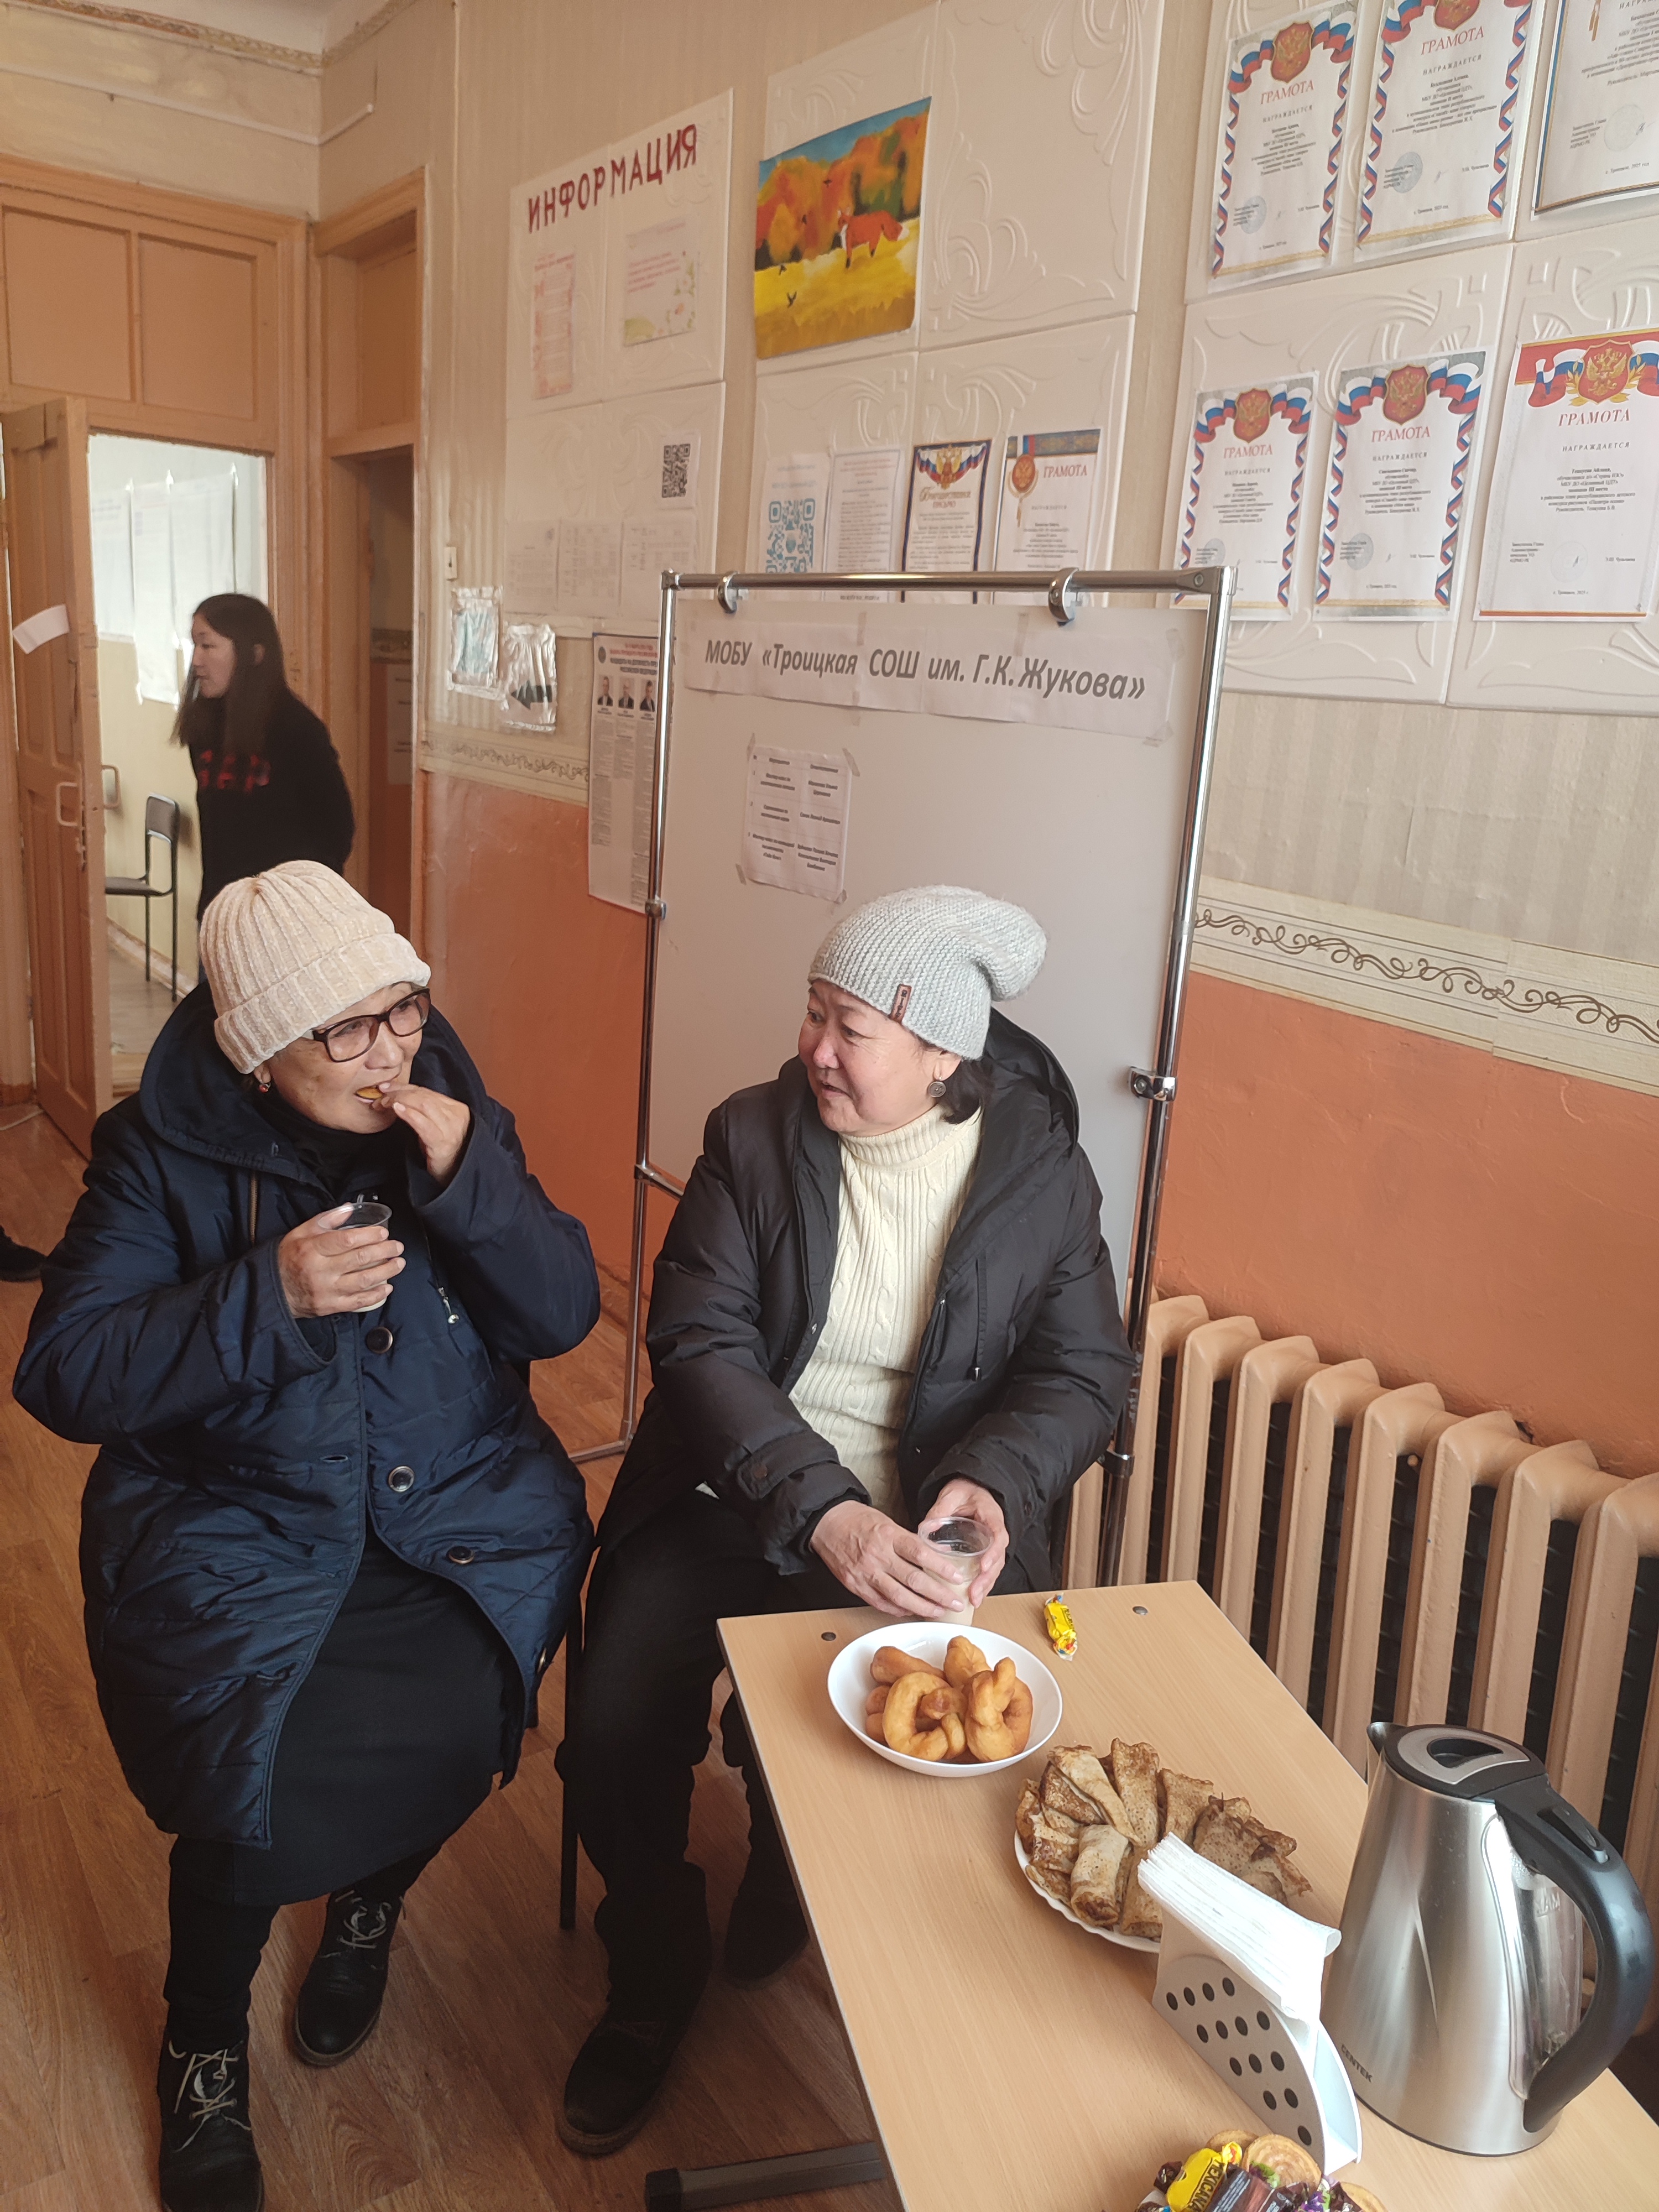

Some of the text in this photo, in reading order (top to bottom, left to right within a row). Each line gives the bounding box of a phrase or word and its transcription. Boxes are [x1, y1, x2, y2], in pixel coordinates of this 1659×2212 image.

[1421, 25, 1484, 55] ГРАМОТА
[1423, 54, 1482, 76] НАГРАЖДАЕТСЯ
[1260, 80, 1314, 105] ГРАМОТА
[528, 123, 697, 234] ИНФОРМАЦИЯ
[1558, 408, 1630, 427] ГРАМОТА
[1371, 426, 1431, 442] ГРАМОТА
[1224, 445, 1273, 459] ГРАМОТА
[1372, 452, 1427, 461] НАГРАЖДАЕТСЯ
[1562, 442, 1630, 452] НАГРАЖДАЕТСЯ
[1043, 464, 1087, 478] ГРАМОТА
[705, 640, 753, 666] МОБУ
[762, 643, 858, 679] «Троицкая
[869, 649, 920, 679] СОШ
[927, 658, 964, 682] им.
[1341, 2043, 1373, 2083] CENTEK
[1188, 2158, 1226, 2212] MEXICANA
